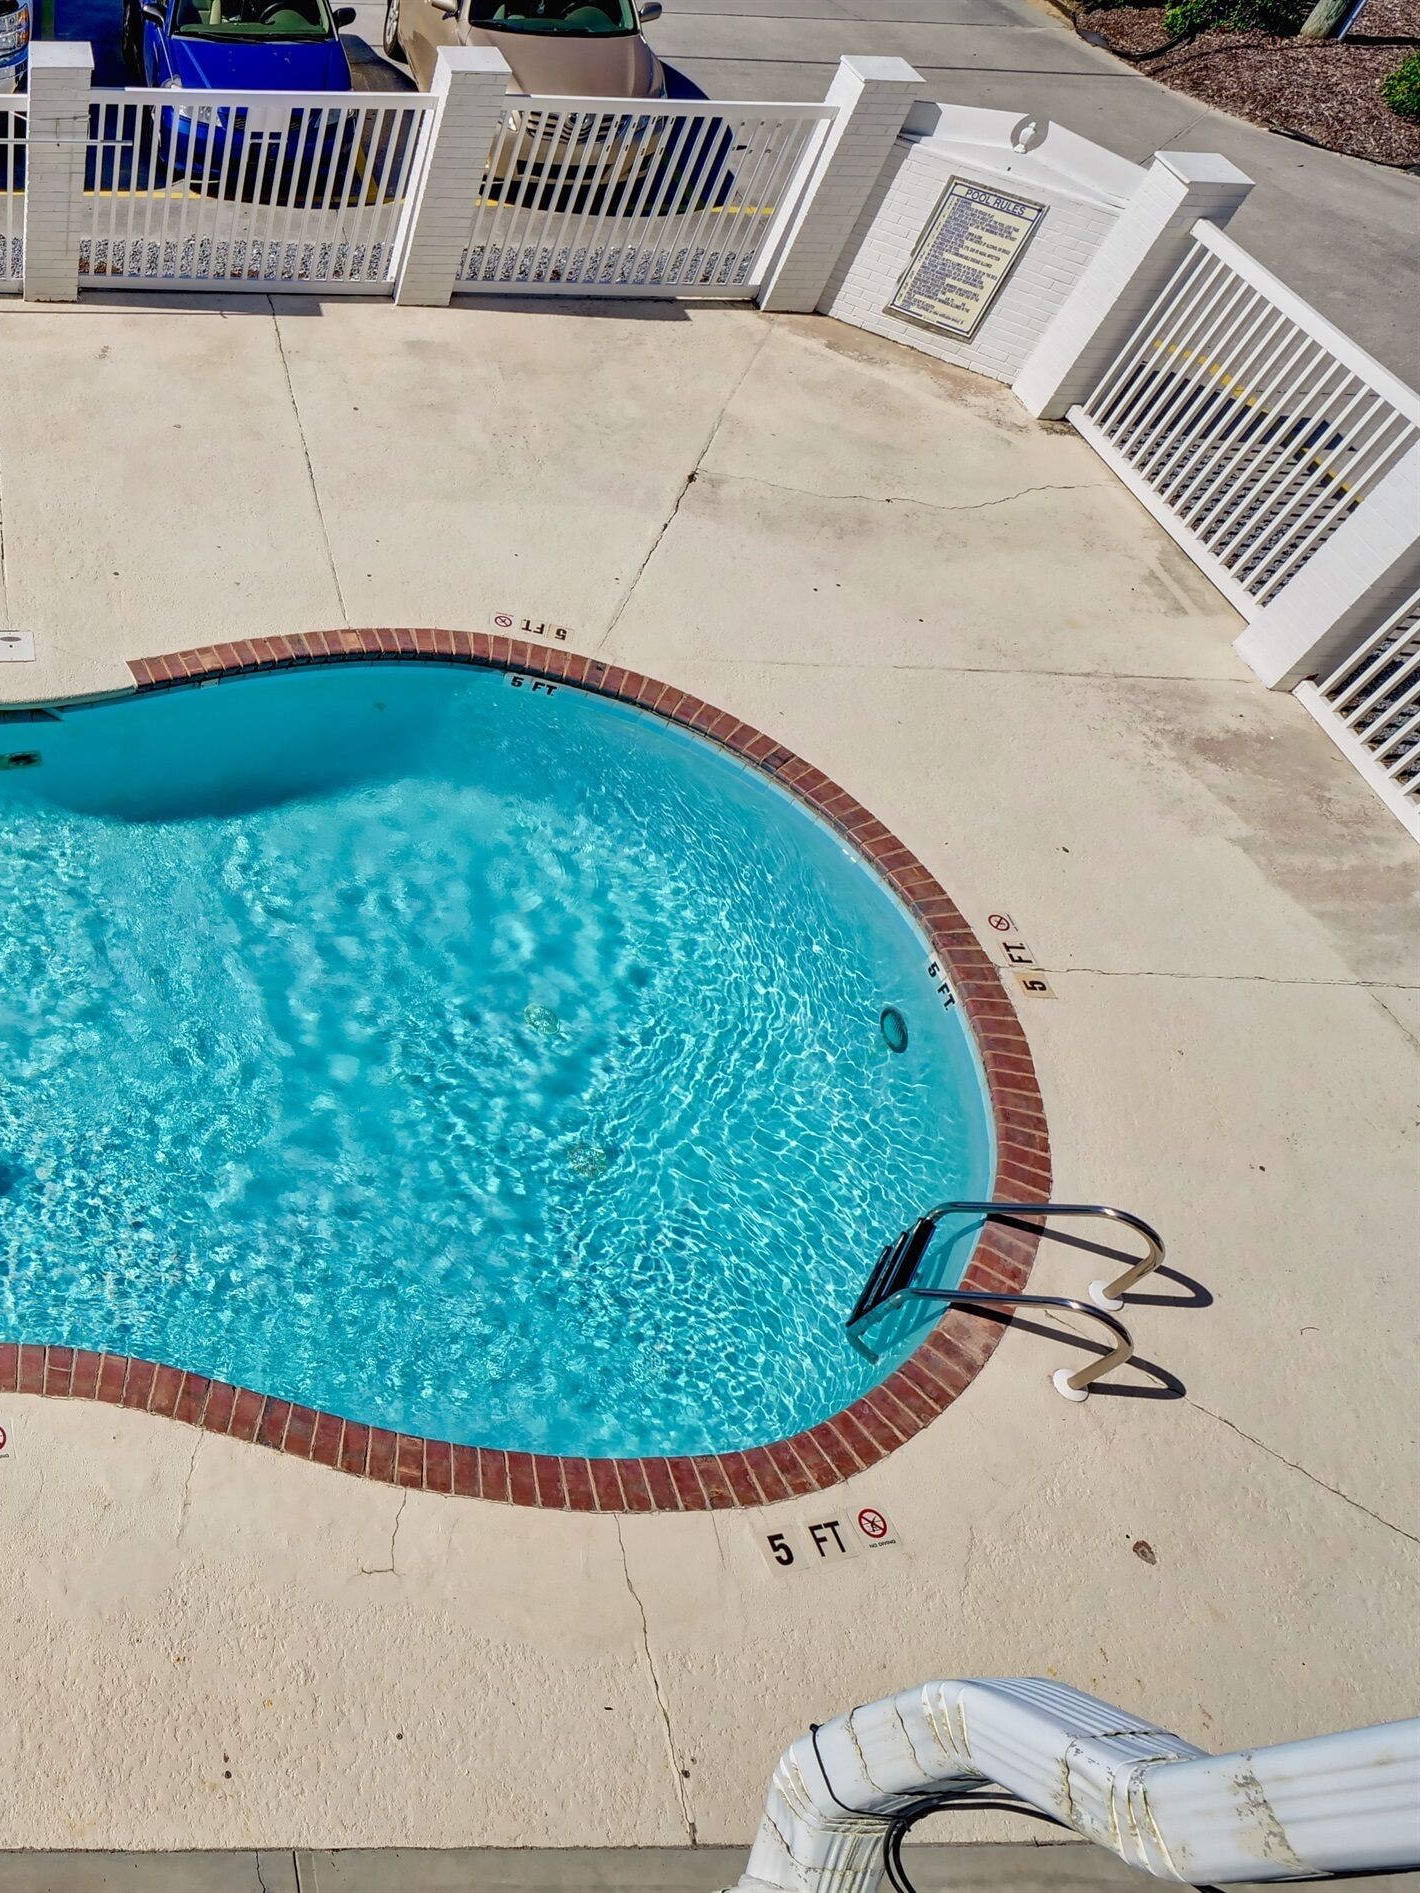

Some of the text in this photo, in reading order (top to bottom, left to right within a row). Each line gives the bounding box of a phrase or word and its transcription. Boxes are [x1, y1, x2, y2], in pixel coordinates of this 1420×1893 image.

[965, 189, 992, 206] POOL
[994, 198, 1026, 215] RULES
[555, 628, 567, 640] 5
[511, 676, 524, 687] 5
[928, 962, 939, 978] 5
[1023, 980, 1047, 991] 5
[767, 1521, 846, 1566] 5 FT
